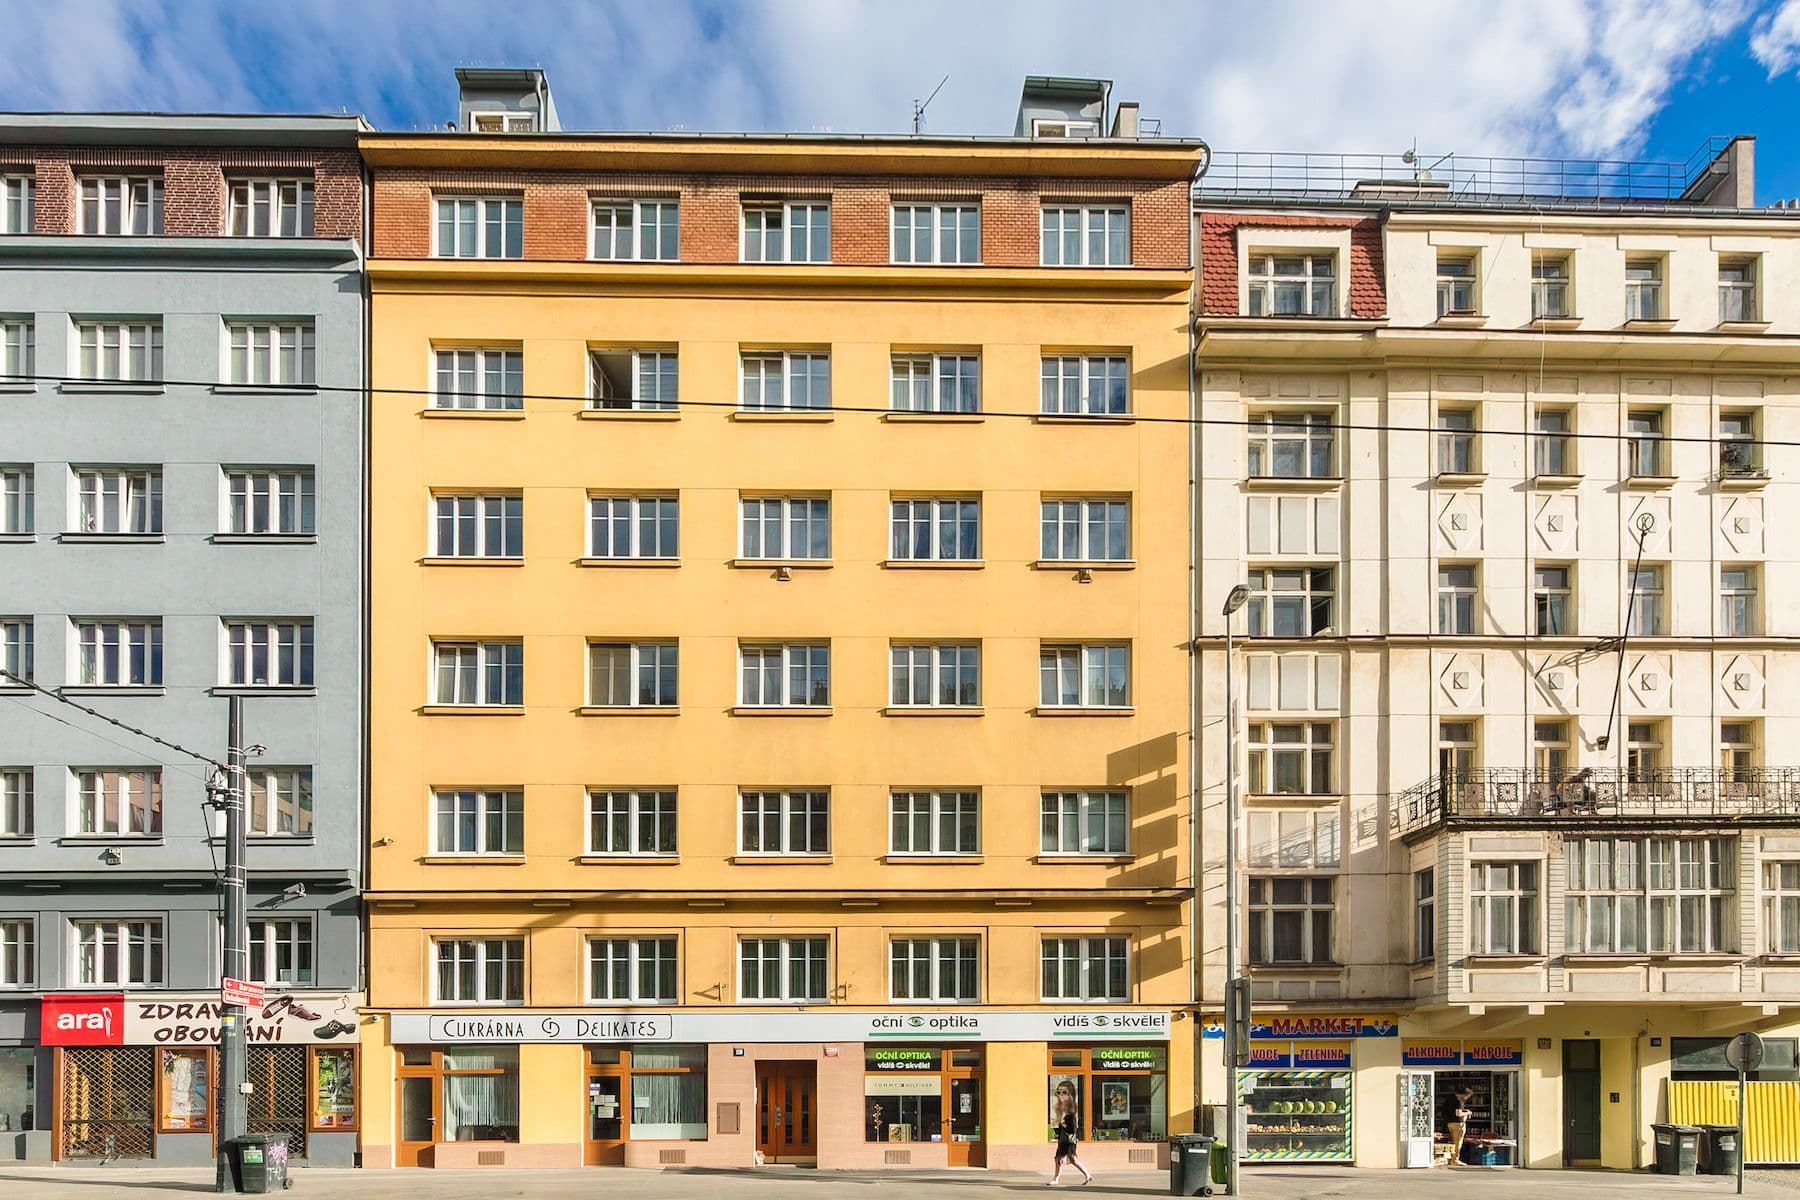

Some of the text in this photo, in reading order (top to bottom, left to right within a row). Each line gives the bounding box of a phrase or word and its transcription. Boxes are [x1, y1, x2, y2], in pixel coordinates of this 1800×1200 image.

[138, 1002, 222, 1020] ZDRAV
[57, 1013, 104, 1030] ara
[871, 1015, 979, 1031] oční optika
[1053, 1014, 1166, 1027] vidíš skvěle!
[1271, 1017, 1365, 1035] MARKET
[443, 1019, 657, 1038] CUKRÁRNA DELIKATES
[875, 1050, 932, 1060] OČNÍ OPTIKA
[1100, 1049, 1123, 1060] OČNÍ
[1250, 1048, 1280, 1061] VOCE
[1298, 1048, 1346, 1061] ZELENINA
[1407, 1045, 1456, 1059] ALKOHOL
